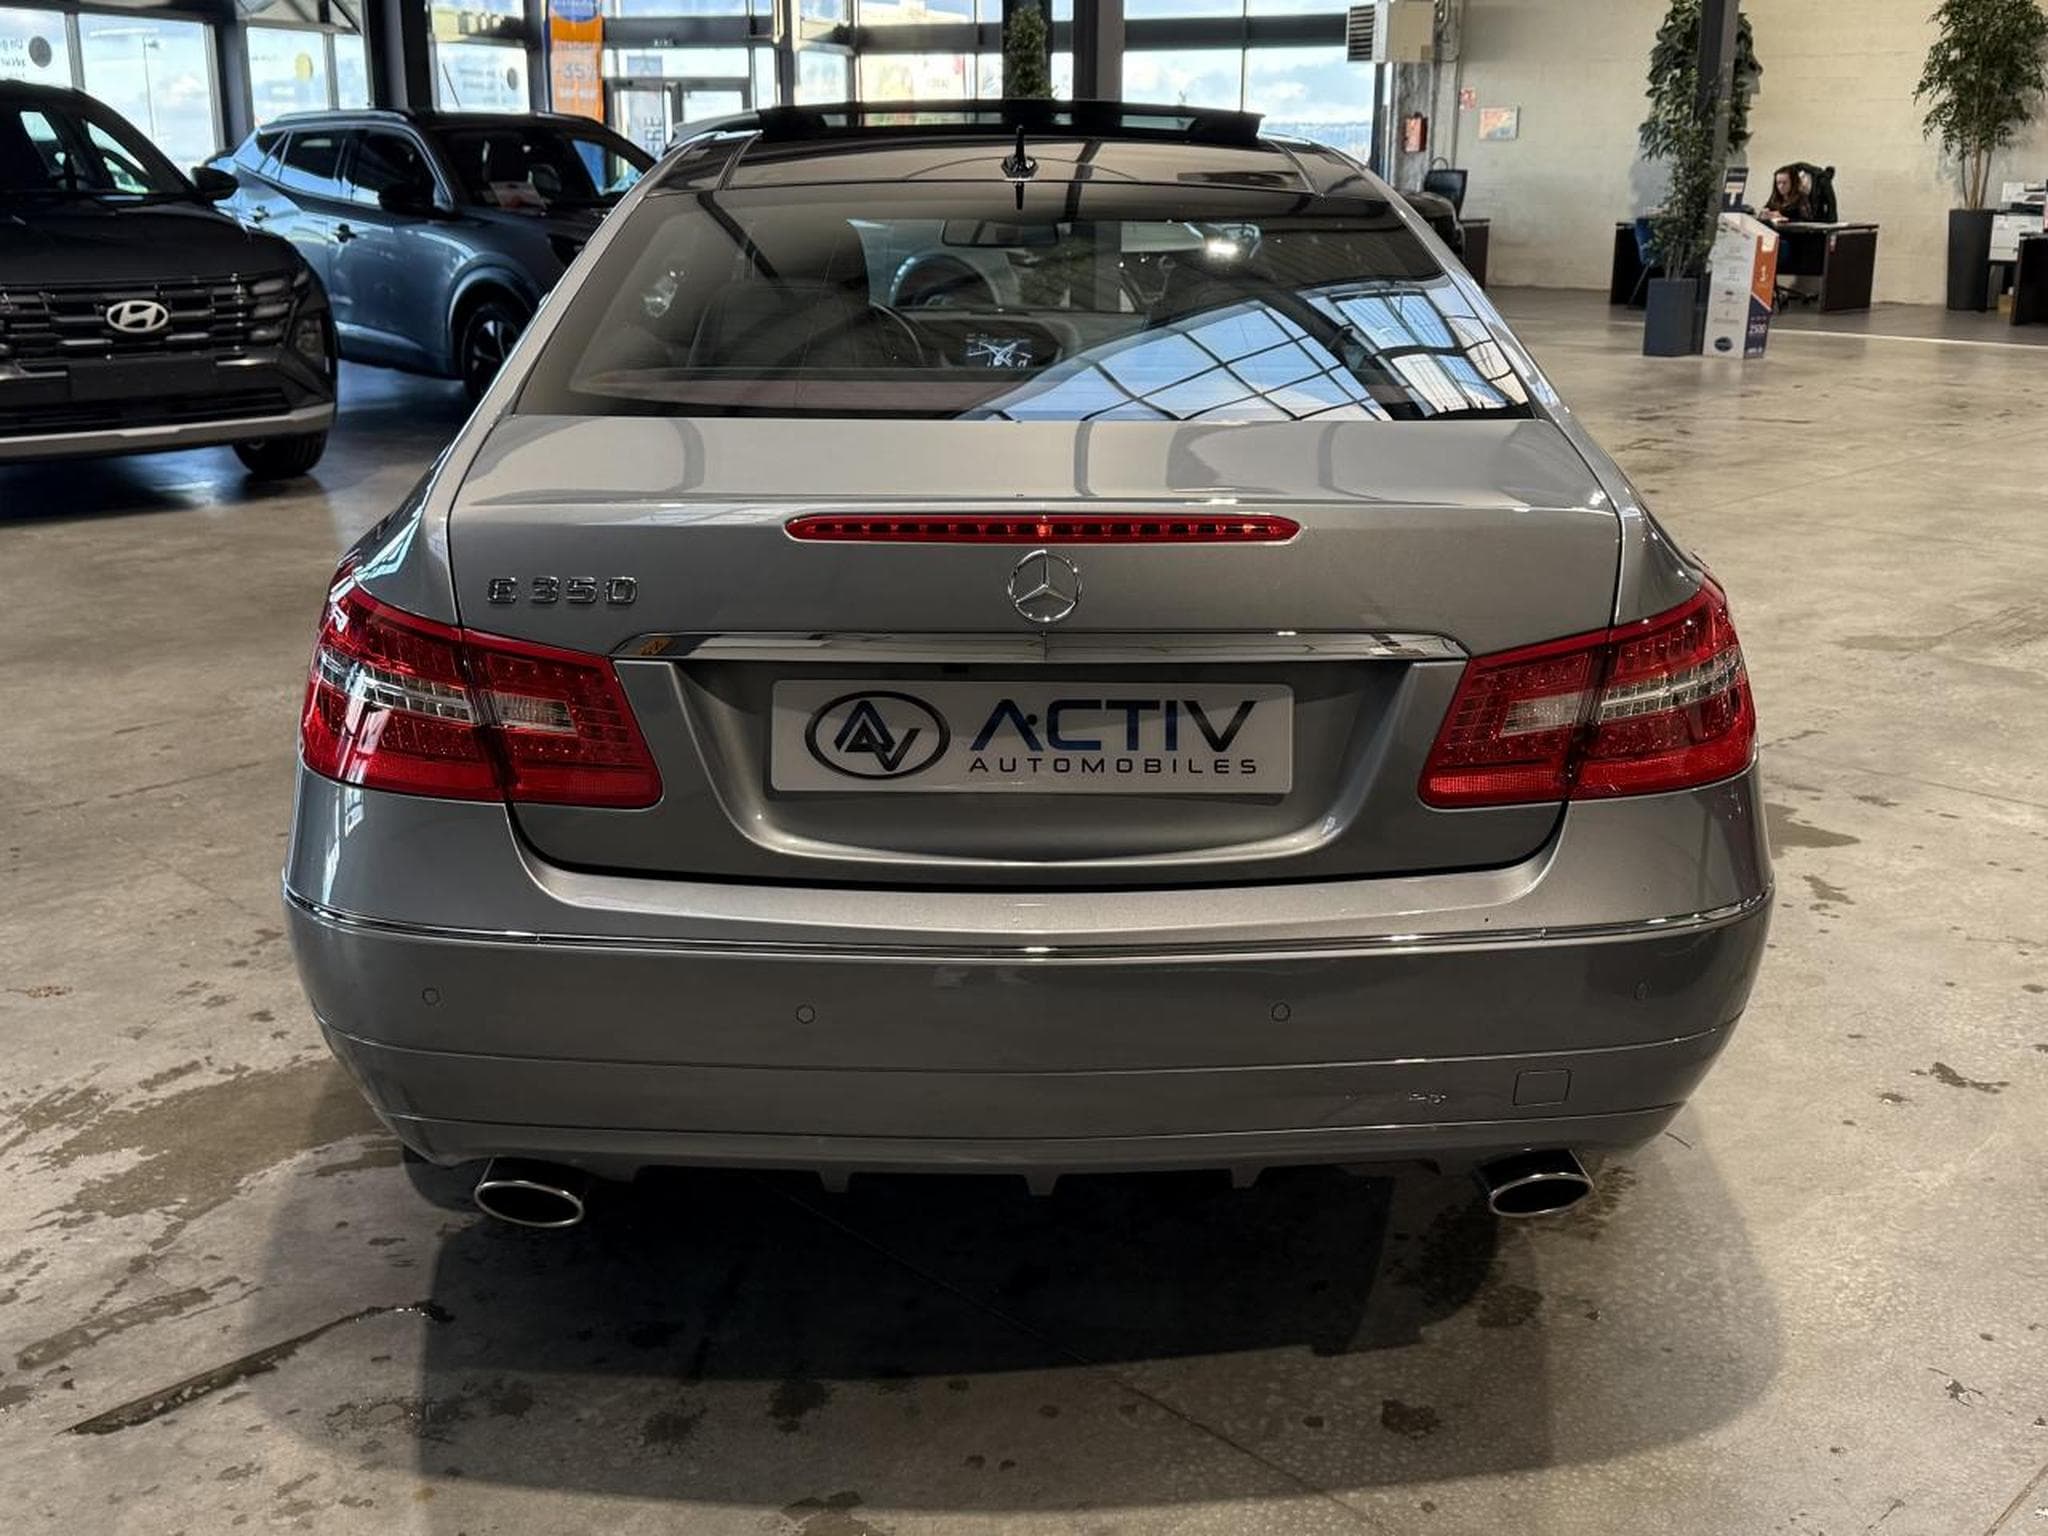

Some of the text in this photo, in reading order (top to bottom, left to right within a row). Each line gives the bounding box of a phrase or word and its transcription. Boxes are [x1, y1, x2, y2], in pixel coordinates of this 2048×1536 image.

[487, 575, 639, 605] E 350
[969, 698, 1257, 753] ACTIV
[968, 757, 1258, 775] AUTOMOBILES
